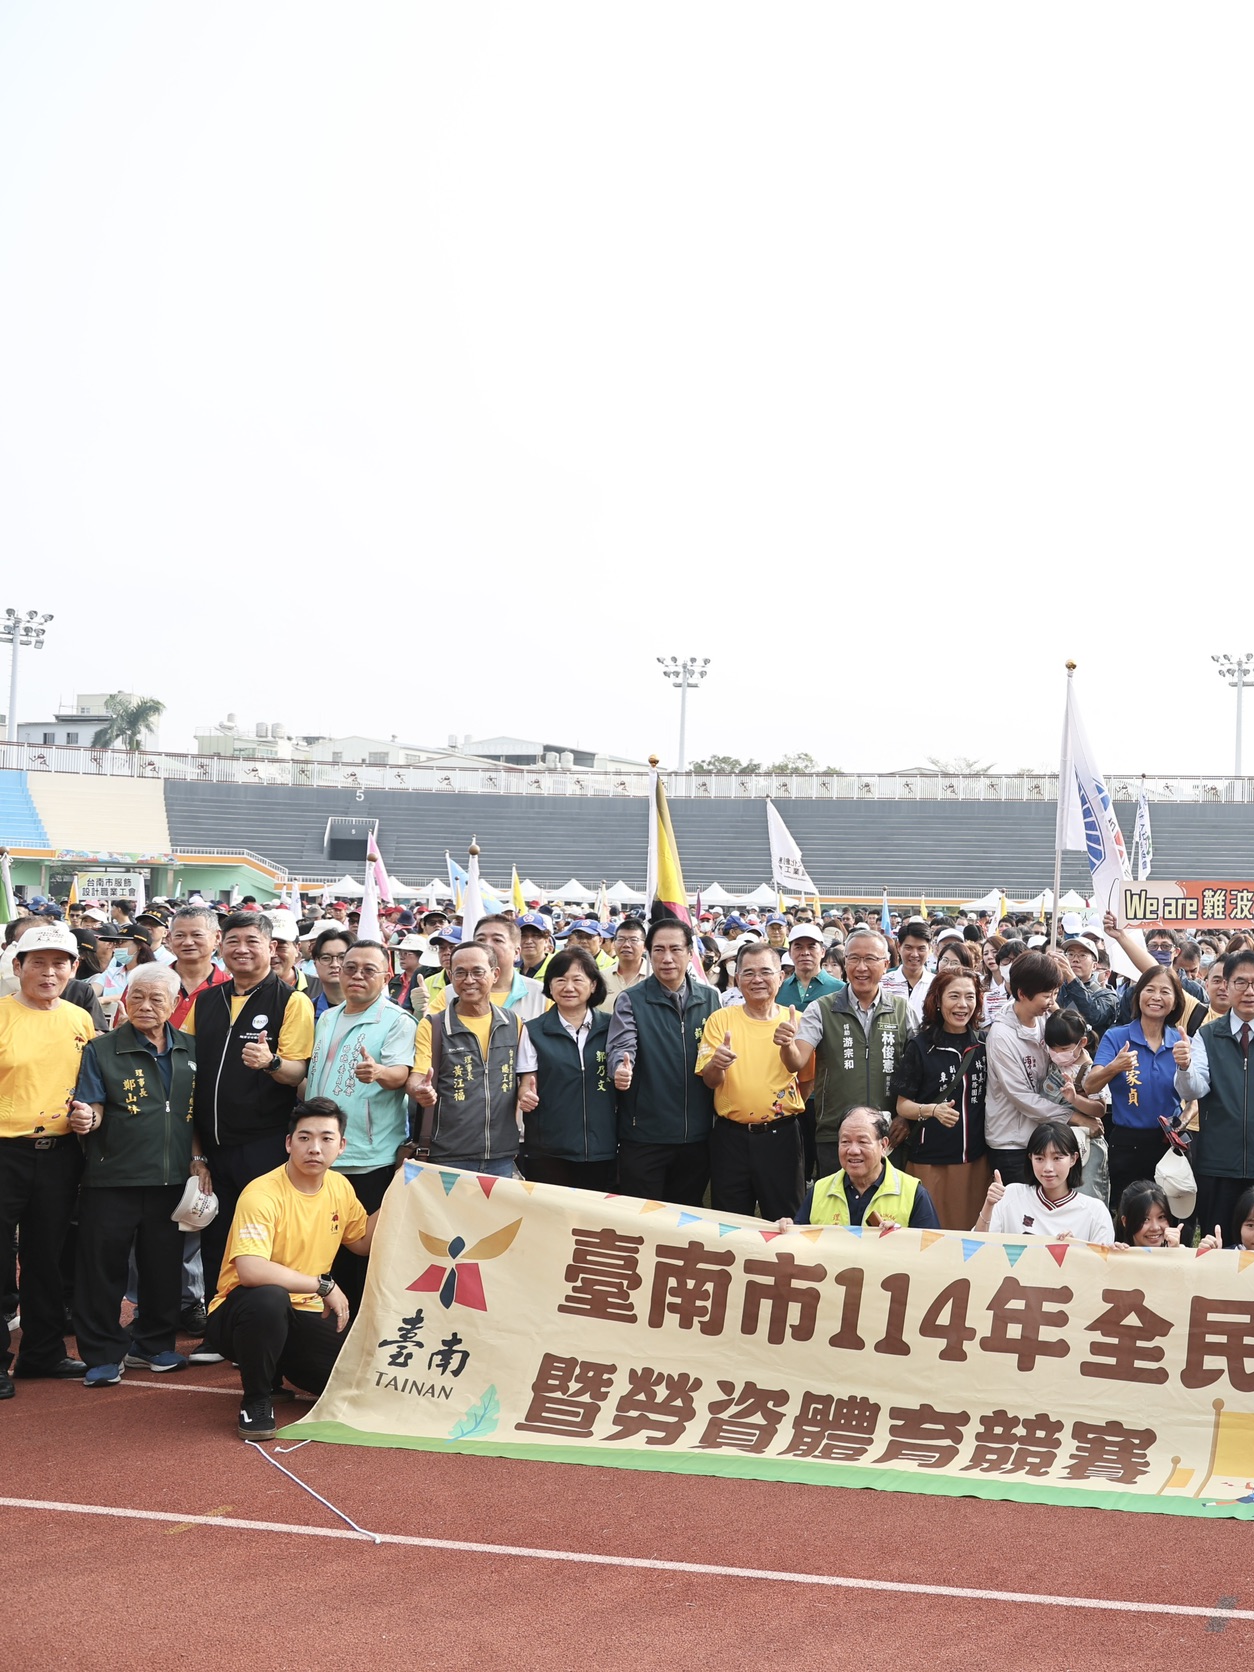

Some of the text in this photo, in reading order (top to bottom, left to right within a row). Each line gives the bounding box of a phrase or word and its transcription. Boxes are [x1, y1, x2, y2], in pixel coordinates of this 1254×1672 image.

[355, 789, 365, 801] 5
[82, 888, 136, 897] 設計職業工會
[87, 878, 132, 887] 台南市服飾
[1124, 889, 1158, 920] We
[1162, 896, 1200, 920] are
[842, 1036, 855, 1070] 游宗和
[881, 1031, 896, 1074] 林俊憲
[134, 1068, 149, 1098] 理事長
[452, 1064, 466, 1102] 黃江福
[595, 1050, 607, 1092] 郭乃文
[1125, 1062, 1143, 1107] 家貞
[378, 1308, 471, 1378] 臺南
[374, 1370, 454, 1401] TAINAN
[514, 1352, 1158, 1485] 暨勞資體育競賽
